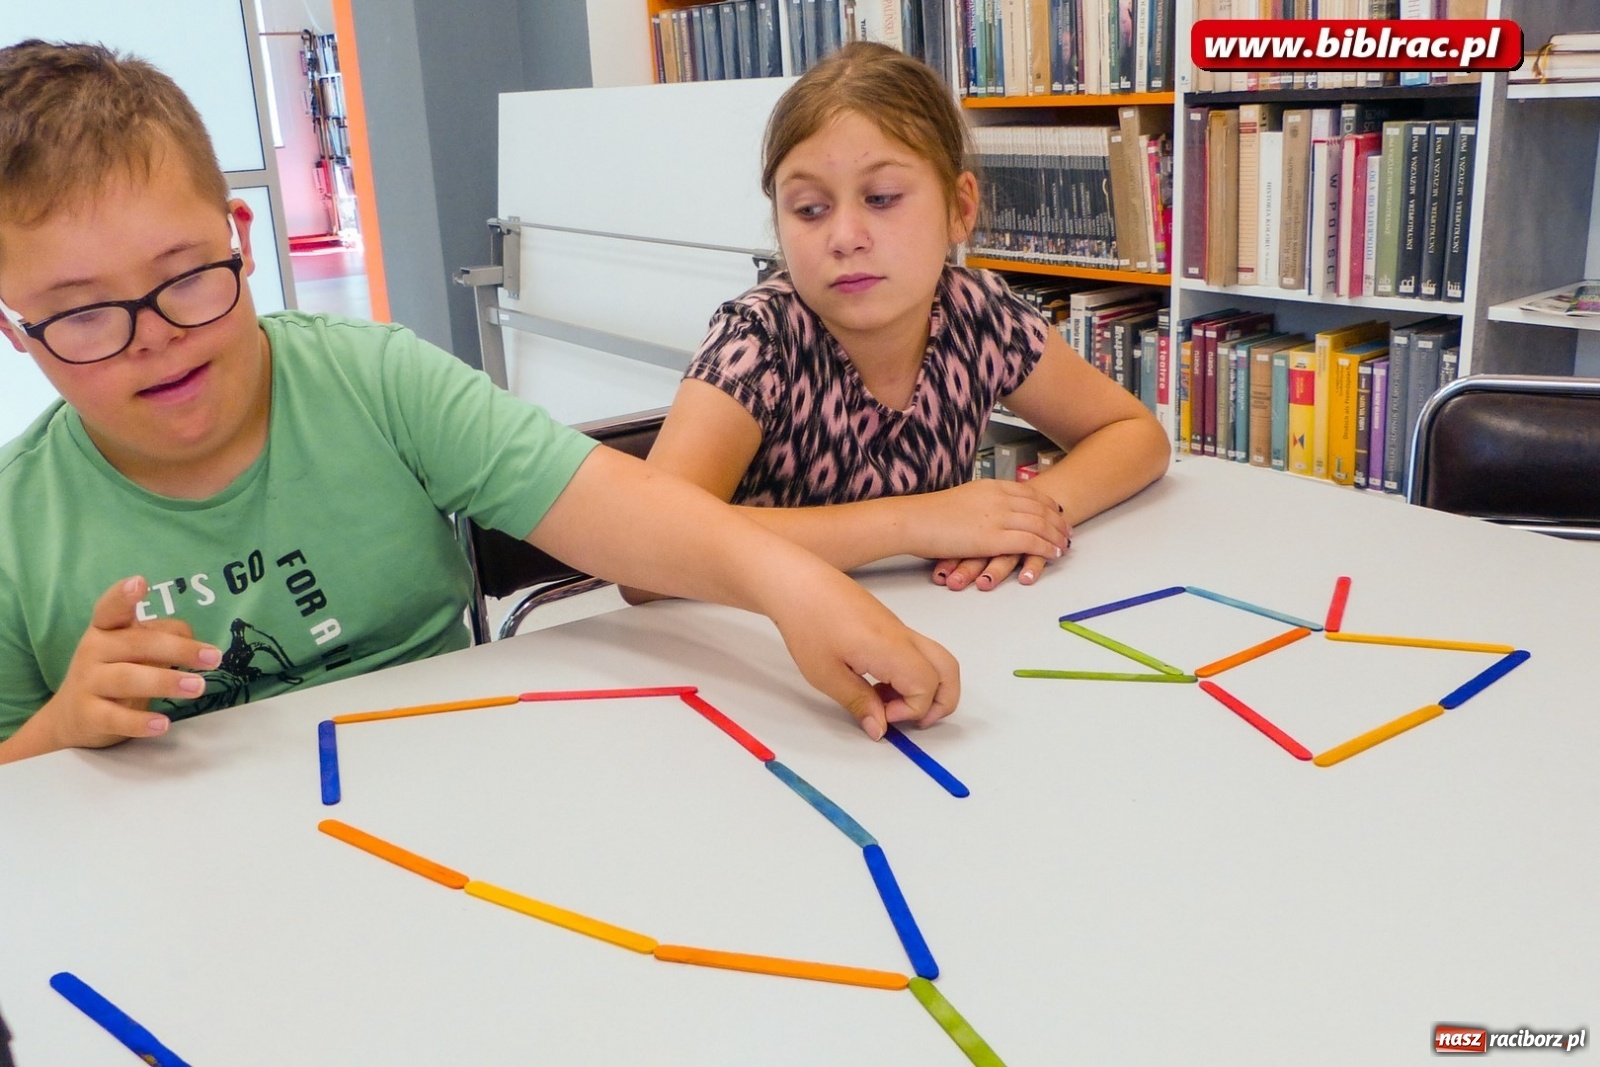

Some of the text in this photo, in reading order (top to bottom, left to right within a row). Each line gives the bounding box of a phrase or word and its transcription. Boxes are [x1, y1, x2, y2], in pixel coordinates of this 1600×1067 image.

[1367, 170, 1376, 182] DO
[1367, 195, 1375, 207] OD
[1384, 186, 1393, 235] ENCYKLOPEDIA
[1406, 135, 1419, 250] ENCYKLOPEDIA MUZYCZNA PWM
[1428, 137, 1442, 254] ENCYKLOPEDIA MUZYCZNA PWM
[1452, 135, 1468, 253] ENCYKLOPEDIA MUZYCZNA PWM
[1326, 174, 1338, 290] W POLSCE
[1366, 210, 1375, 261] FOTOGRAFIA
[1160, 351, 1168, 389] teatrze
[223, 549, 265, 595] GO
[276, 549, 328, 617] FOR
[310, 617, 342, 646] A
